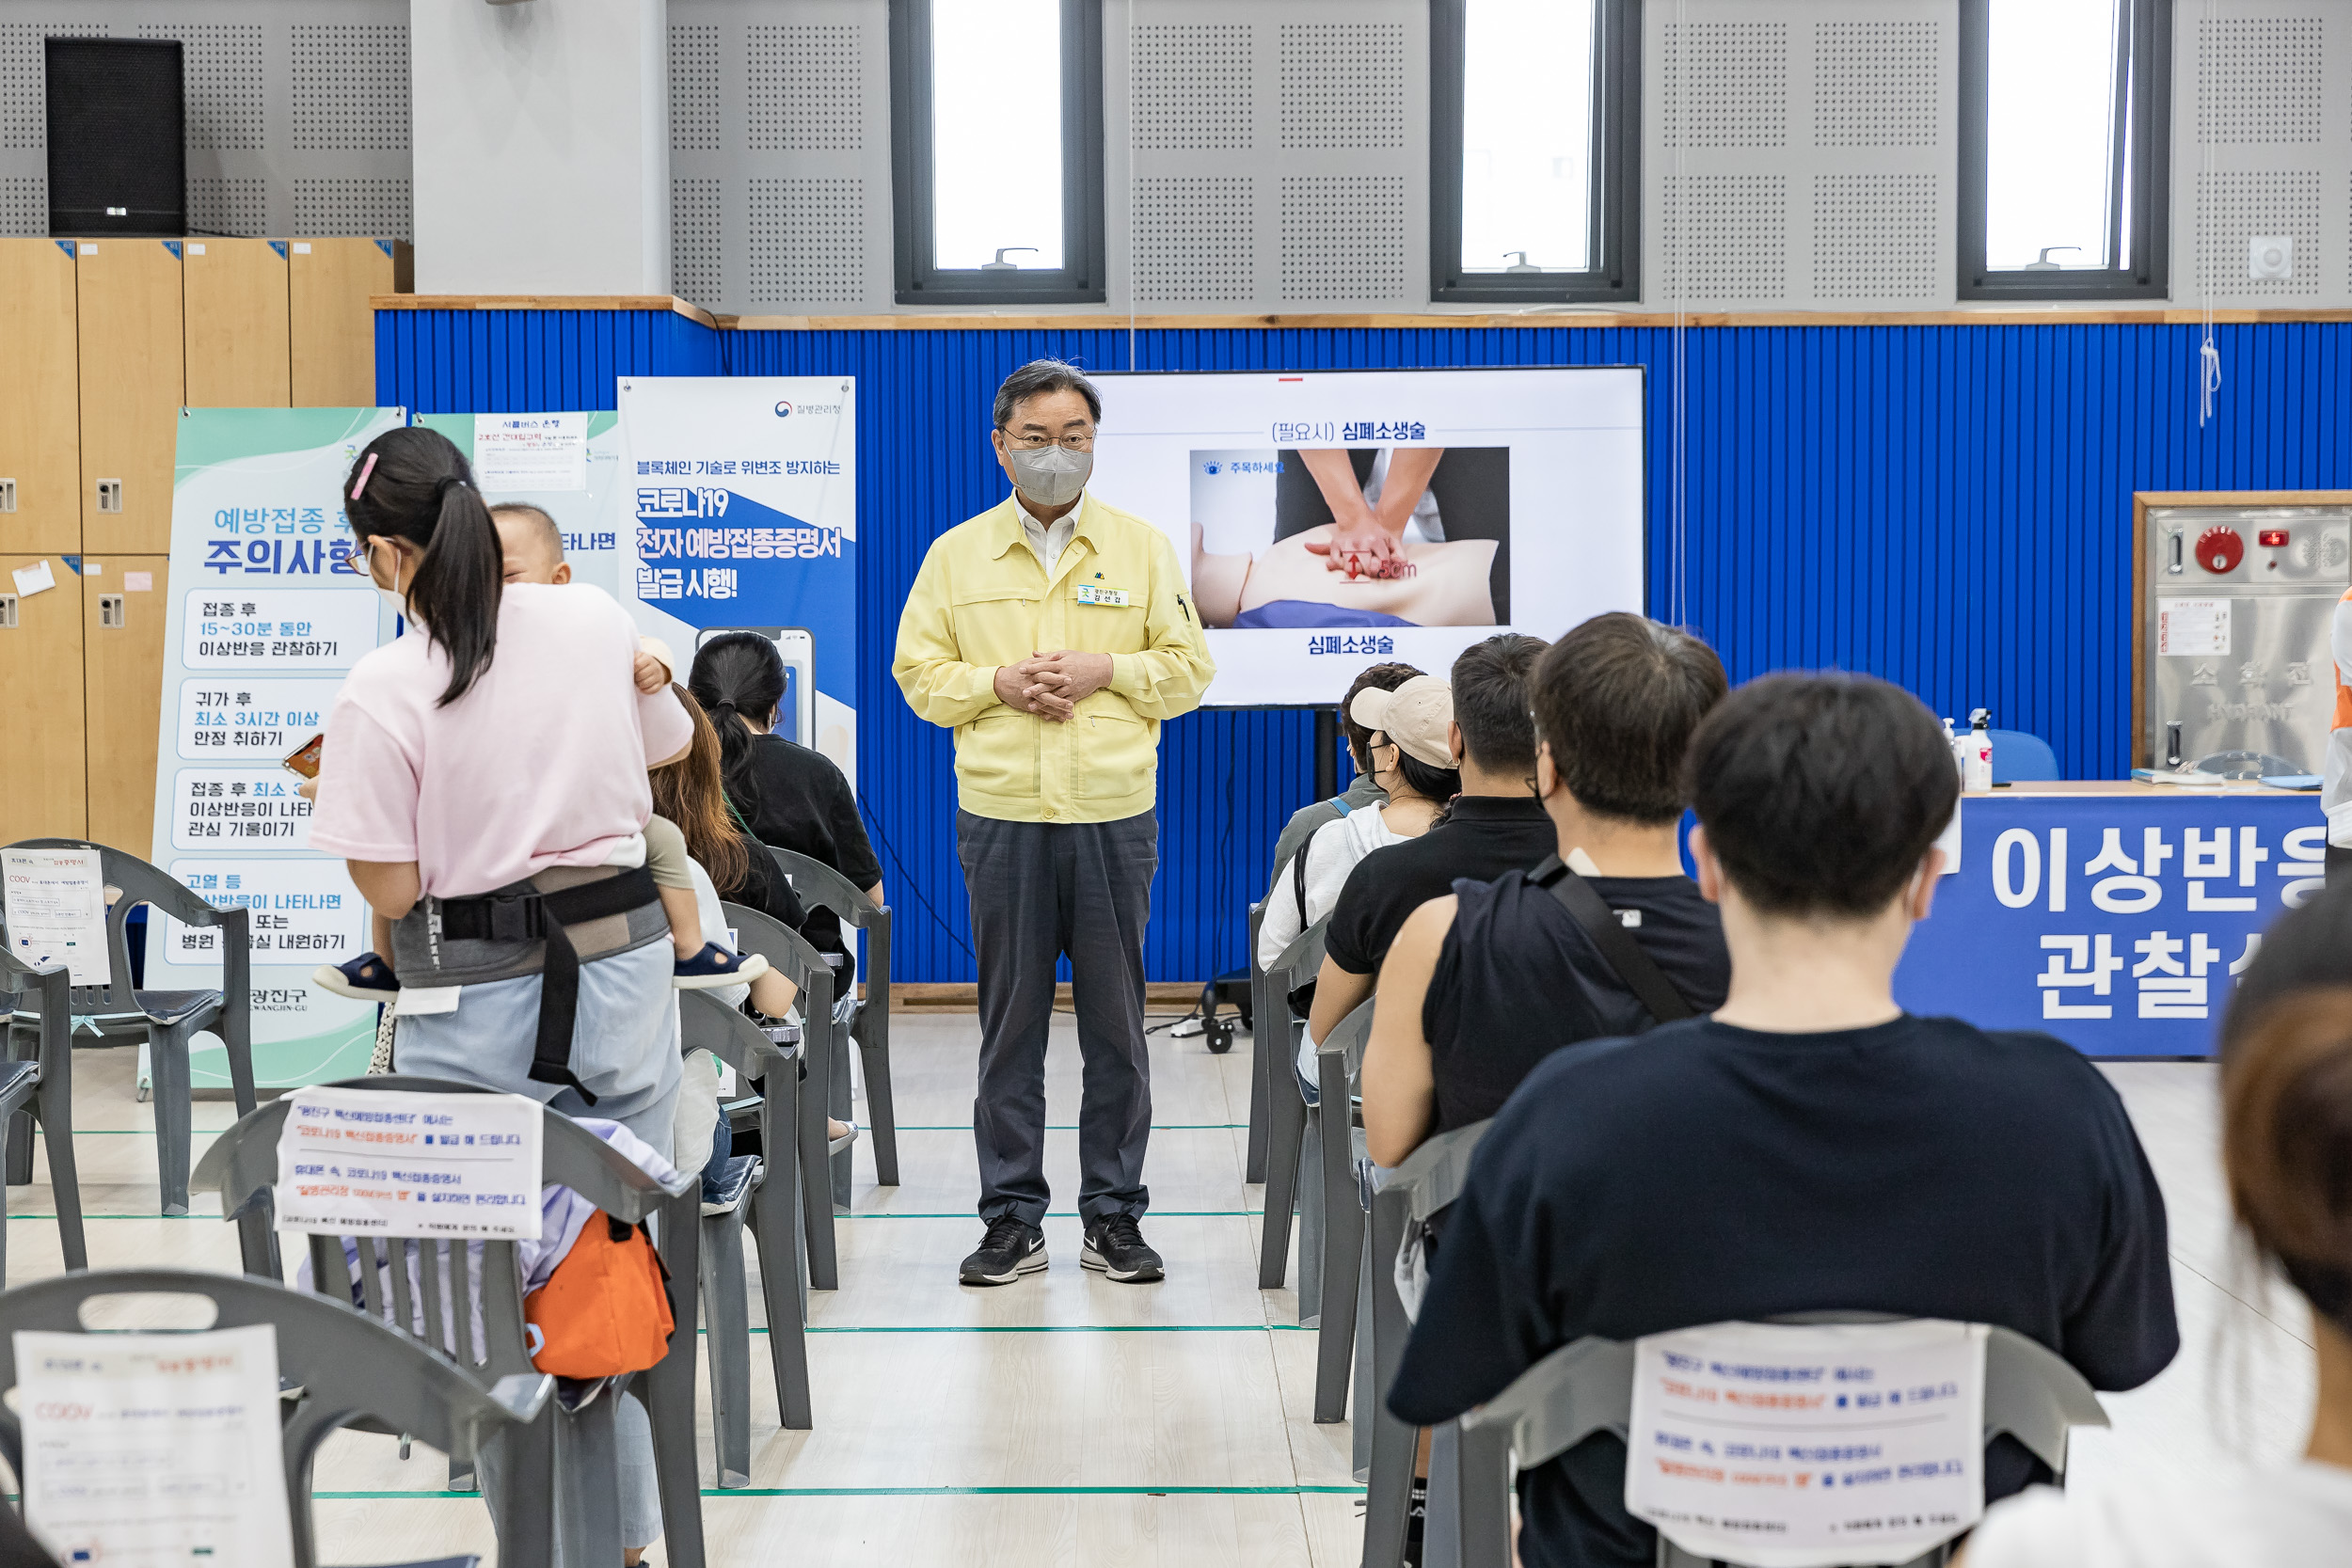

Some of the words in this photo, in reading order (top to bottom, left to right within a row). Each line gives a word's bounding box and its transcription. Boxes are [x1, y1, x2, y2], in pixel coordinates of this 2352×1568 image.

[797, 404, 841, 415] 질병관리청
[1272, 421, 1334, 443] (필요시)
[1342, 421, 1426, 441] 심폐소생술
[637, 461, 691, 475] 블록체인
[696, 461, 737, 475] 기술로
[741, 461, 782, 475] 위변조
[787, 461, 840, 475] 방지하는
[1231, 461, 1285, 474] 주목하세요
[636, 487, 729, 518] 코로나19
[215, 508, 325, 534] 예방접종
[636, 528, 683, 559] 전자
[685, 527, 842, 559] 예방접종증명서
[204, 538, 365, 575] 주의사항
[1378, 560, 1417, 579] 5cm
[637, 567, 683, 599] 발급
[685, 567, 738, 599] 시행!
[202, 602, 235, 617] 접종
[241, 602, 257, 617] 후
[199, 622, 273, 637] 15~30분
[279, 622, 312, 637] 동안
[199, 641, 265, 657] 이상반응
[272, 641, 338, 657] 관찰하기
[1308, 635, 1393, 655] 심폐소생술
[196, 691, 230, 706] 귀가
[235, 691, 252, 706] 후
[195, 712, 228, 726] 최소
[235, 712, 279, 726] 3시간
[286, 712, 320, 726] 이상
[194, 732, 226, 746] 안정
[233, 731, 282, 746] 취하기
[191, 783, 224, 797] 접종
[230, 783, 246, 797] 후
[253, 782, 286, 797] 최소
[190, 802, 273, 816] 이상반응이
[188, 822, 221, 836] 관심
[229, 822, 294, 836] 기울이기
[1991, 825, 2328, 915] 이상반응
[9, 875, 31, 883] COOV
[186, 874, 217, 889] 고열
[226, 874, 241, 889] 등
[201, 895, 267, 909] 상반응이
[275, 895, 342, 910] 나타나면
[256, 914, 289, 928] 또는
[183, 934, 215, 949] 병원
[278, 934, 345, 949] 내원하기
[249, 989, 308, 1004] 광진구
